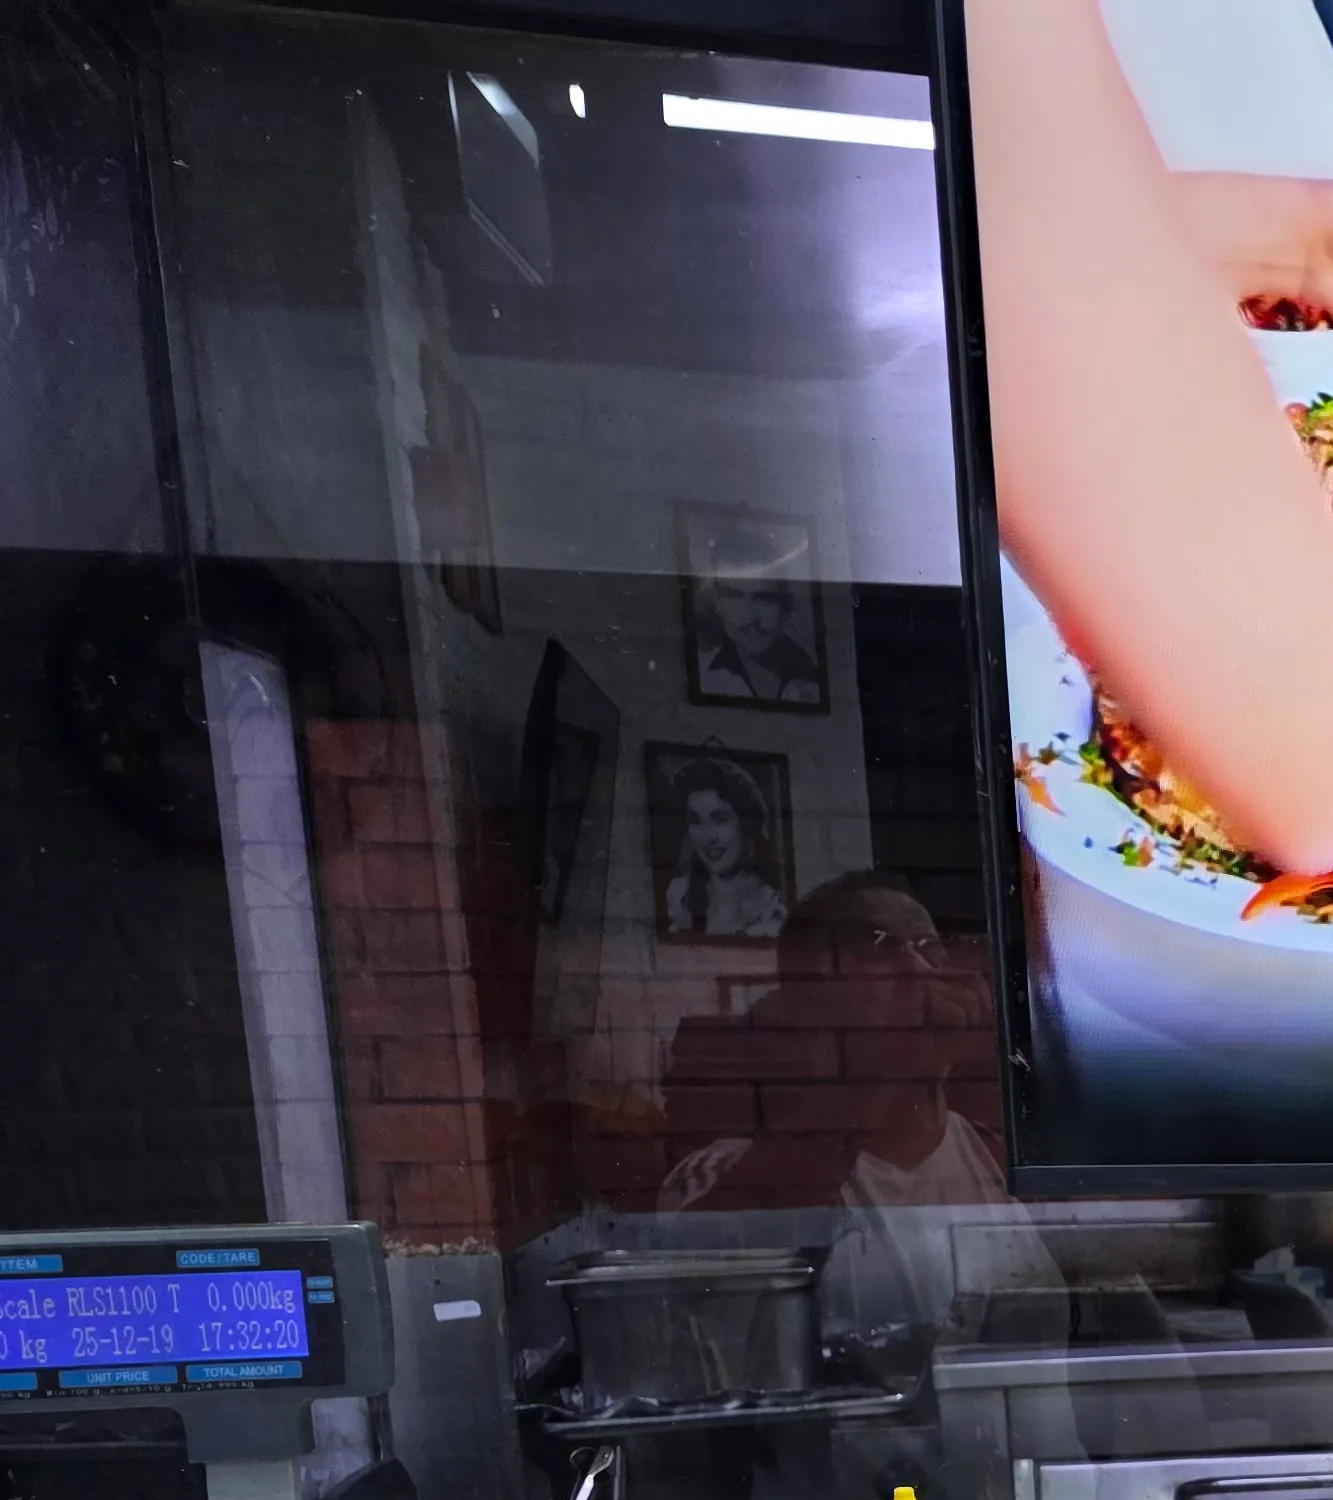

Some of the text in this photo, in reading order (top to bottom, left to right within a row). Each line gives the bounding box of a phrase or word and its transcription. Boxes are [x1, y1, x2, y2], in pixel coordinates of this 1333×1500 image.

[180, 1252, 256, 1265] CODE/TARE
[0, 1288, 56, 1320] cale
[66, 1285, 157, 1316] RLS1100
[168, 1283, 180, 1314] T
[207, 1282, 296, 1313] 0.000kg
[20, 1329, 47, 1363] kg
[72, 1323, 173, 1357] 25-12-19
[199, 1319, 299, 1352] 17:32:20
[86, 1371, 149, 1383] UNIT PRICE
[204, 1365, 284, 1378] TOTAL AMOUNT
